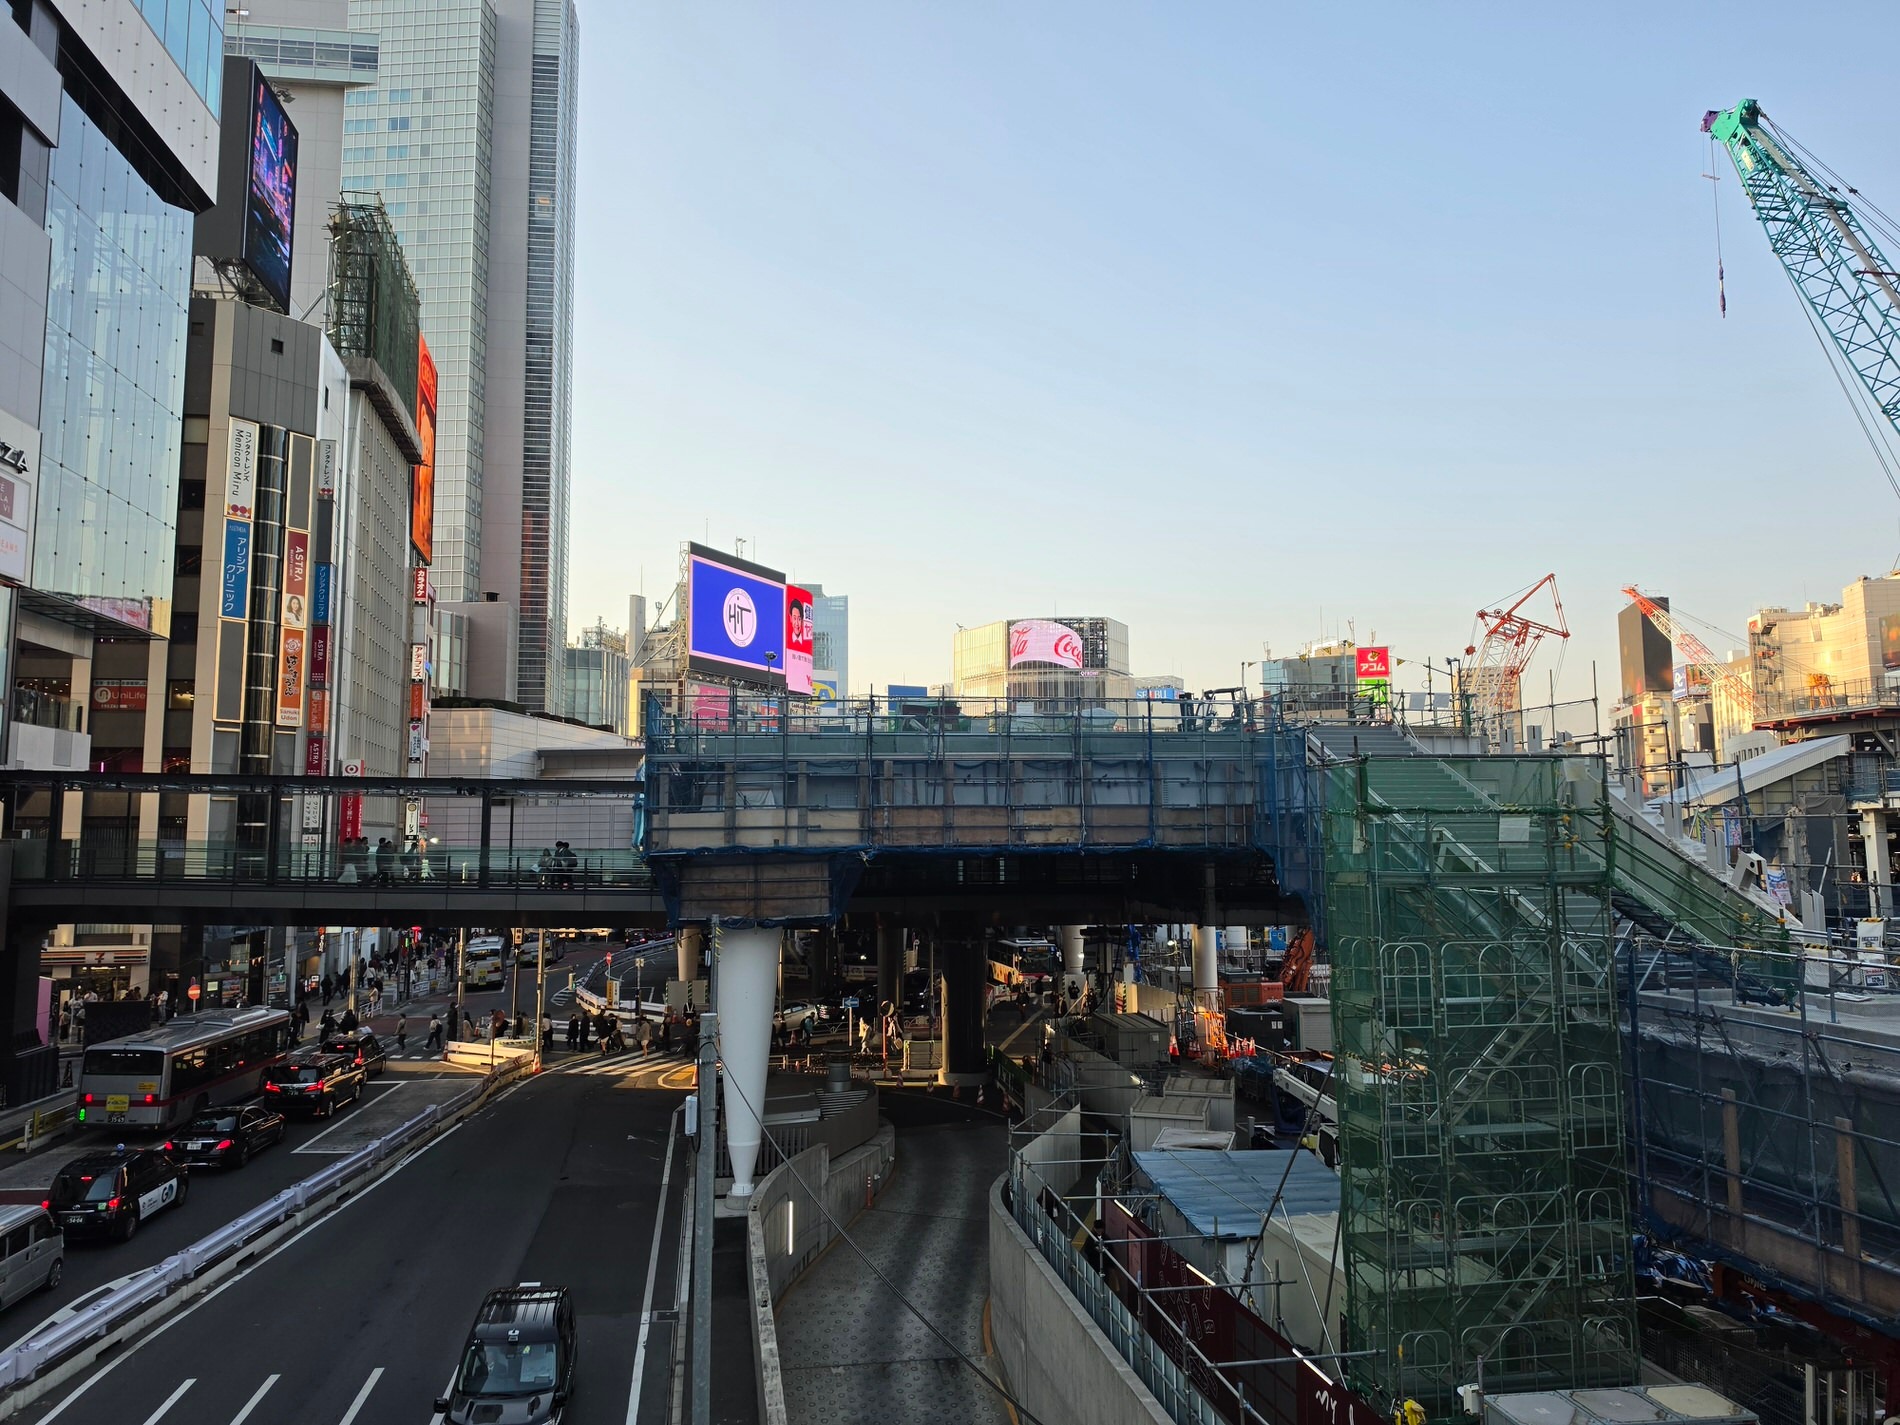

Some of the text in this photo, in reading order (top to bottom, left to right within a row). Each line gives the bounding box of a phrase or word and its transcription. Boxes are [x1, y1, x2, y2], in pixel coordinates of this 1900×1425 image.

[232, 429, 244, 496] Menicon Miru
[236, 537, 247, 574] アリシア
[294, 545, 304, 582] ASTRA
[224, 564, 236, 612] クリニック
[416, 570, 425, 597] カラオケ
[316, 639, 324, 661] ASTRA
[413, 646, 423, 678] アデランス
[1359, 662, 1386, 672] アコム
[312, 743, 320, 765] ASTRA
